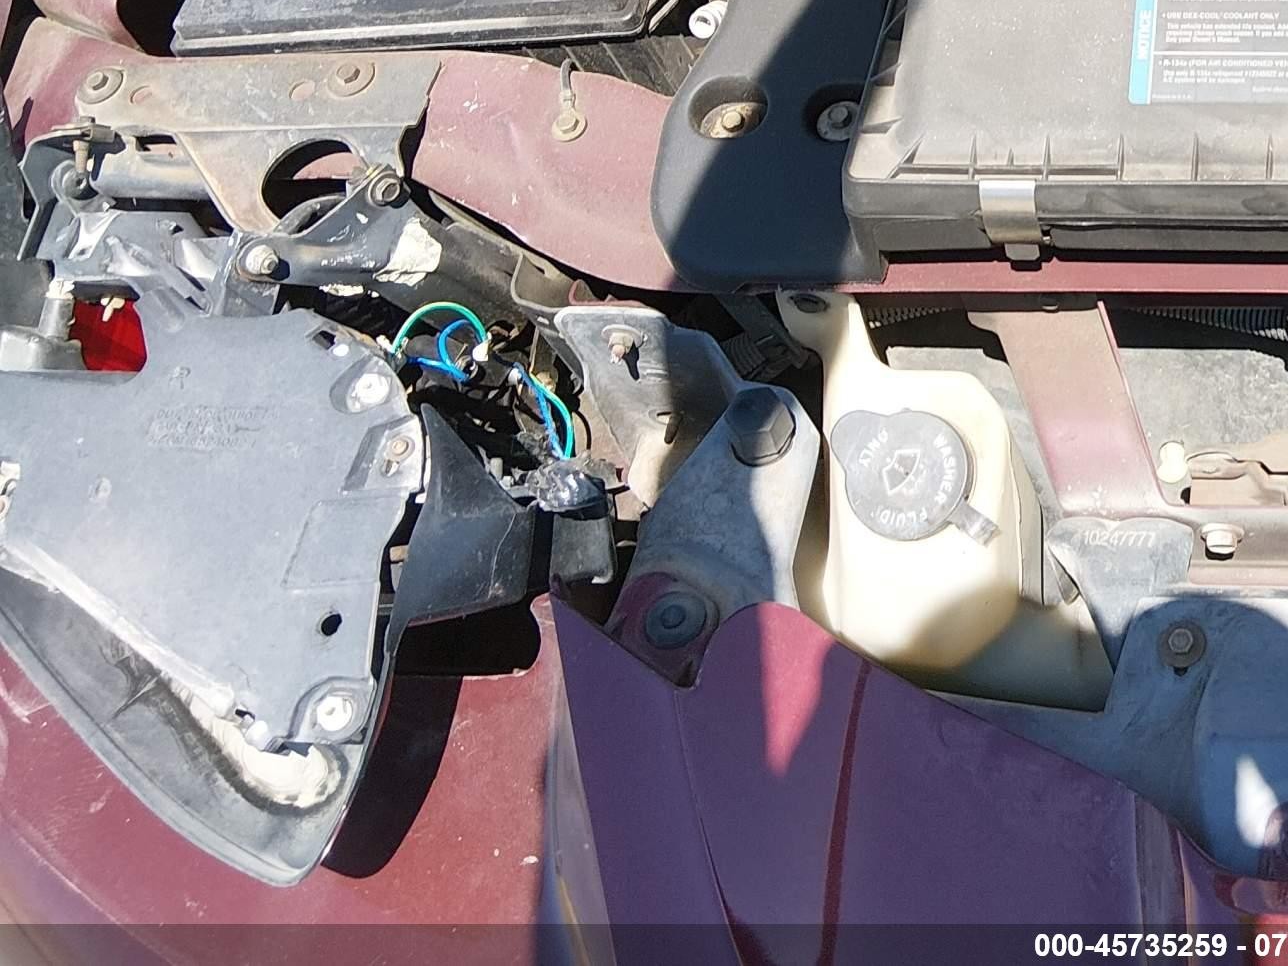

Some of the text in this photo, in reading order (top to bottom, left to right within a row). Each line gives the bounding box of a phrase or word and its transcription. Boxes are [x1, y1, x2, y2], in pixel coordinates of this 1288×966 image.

[1260, 12, 1280, 20] ONLY
[1137, 10, 1151, 59] NOTICE
[859, 428, 956, 527] WASHER FLUID ONLY
[1083, 529, 1156, 547] 10247777
